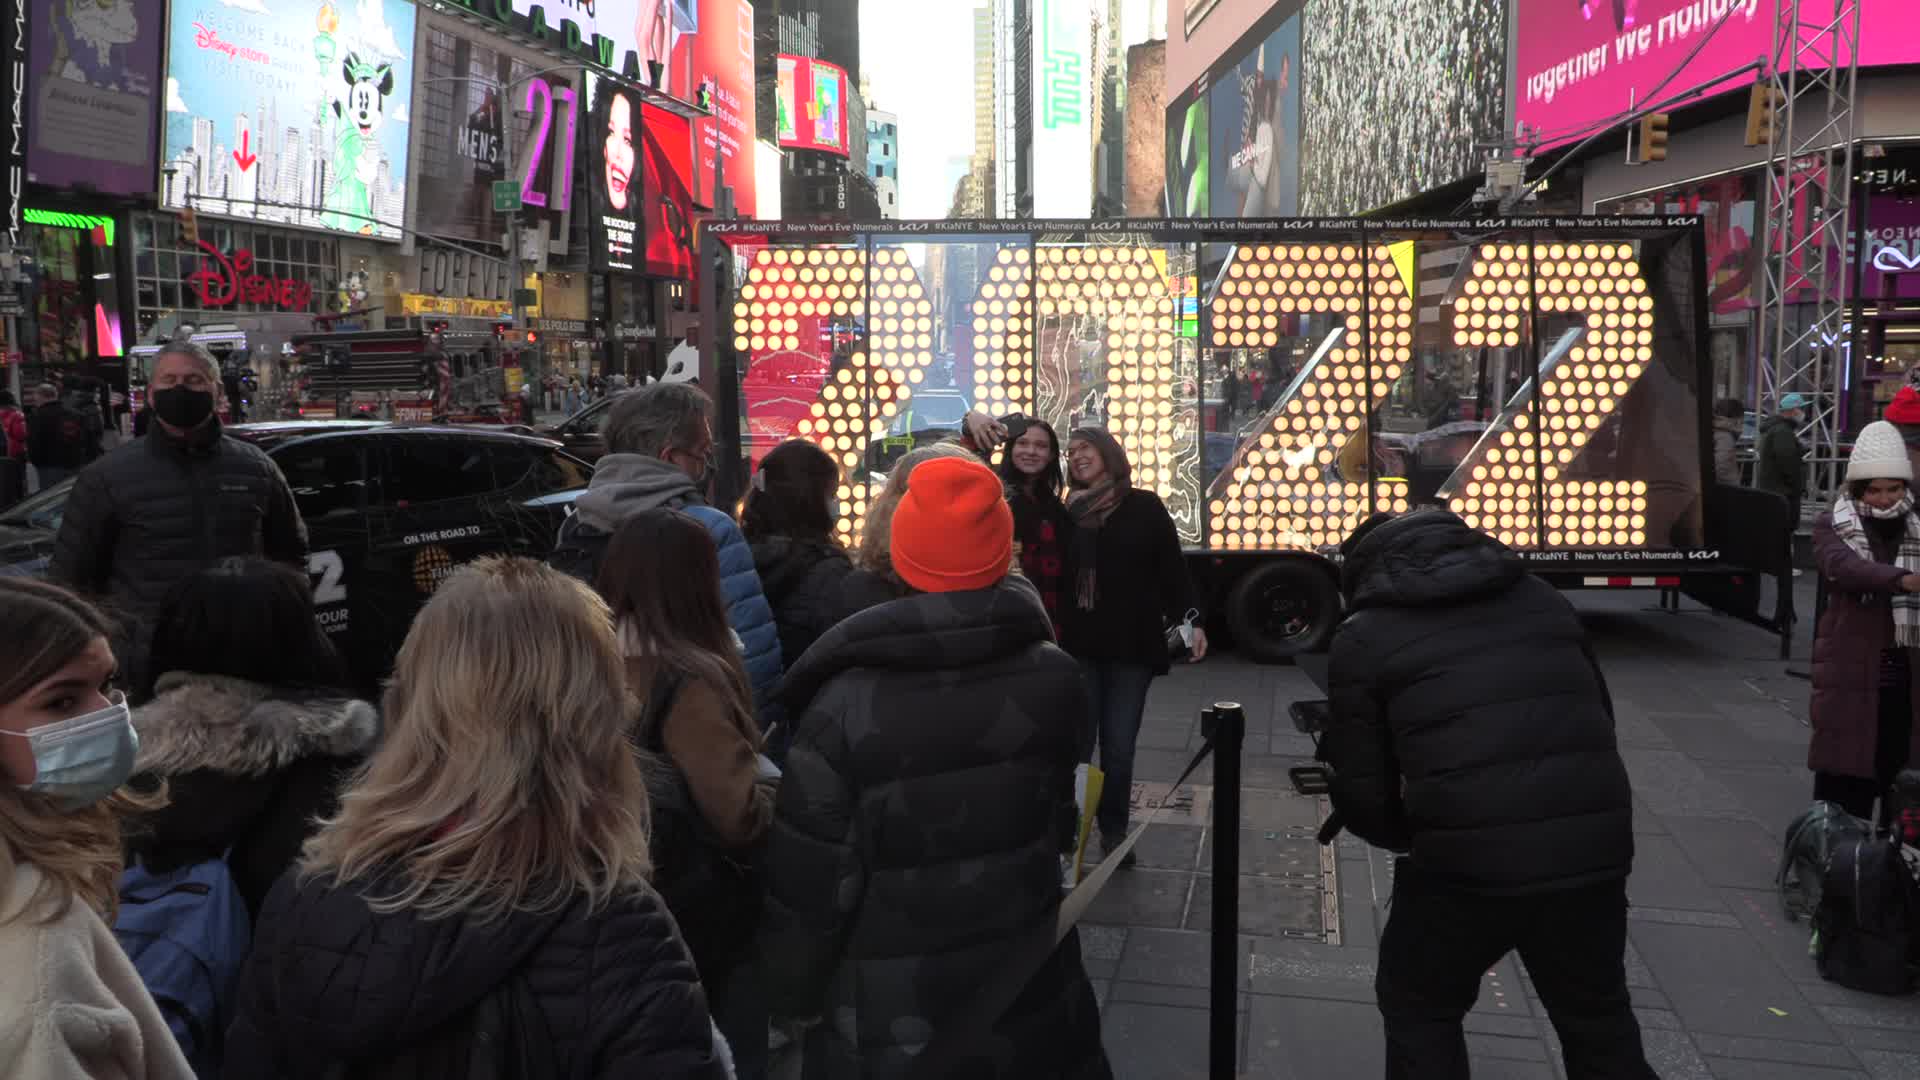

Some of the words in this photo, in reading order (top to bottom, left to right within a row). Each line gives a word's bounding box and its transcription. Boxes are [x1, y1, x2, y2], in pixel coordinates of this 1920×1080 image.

[457, 125, 498, 164] MENS
[837, 175, 846, 209] 1500
[743, 222, 781, 232] #KiaNYE
[787, 222, 806, 232] New
[809, 222, 833, 232] Year's
[835, 222, 850, 232] Eve
[853, 222, 893, 231] Numerals
[935, 221, 972, 231] #KiaNYE
[979, 221, 998, 231] New
[1000, 221, 1026, 231] Year's
[1028, 221, 1043, 230] Eve
[1045, 221, 1085, 230] Numerals
[1127, 220, 1165, 230] #KiaNYE
[1171, 220, 1190, 230] New
[1192, 220, 1218, 230] Year's
[1220, 220, 1235, 229] Eve
[1238, 220, 1278, 229] Numerals
[1319, 219, 1358, 229] #KiaNYE
[1364, 219, 1382, 229] New
[1385, 219, 1410, 228] Year's
[1412, 219, 1428, 228] Eve
[1430, 219, 1471, 228] Numerals
[1511, 218, 1550, 228] #KiaNYE
[1556, 218, 1574, 228] New
[1576, 218, 1602, 227] Year's
[1604, 218, 1620, 227] Eve
[1622, 218, 1662, 227] Numerals
[415, 246, 514, 300] FOREVE
[404, 535, 419, 545] ON
[420, 531, 439, 542] THE
[440, 527, 465, 539] ROAD
[466, 525, 480, 535] TO
[1530, 551, 1568, 560] #KiaNYE
[1575, 551, 1593, 560] New
[1596, 551, 1621, 560] Year's
[1623, 551, 1639, 560] Eve
[1642, 550, 1683, 560] Numerals
[315, 608, 349, 625] OUR
